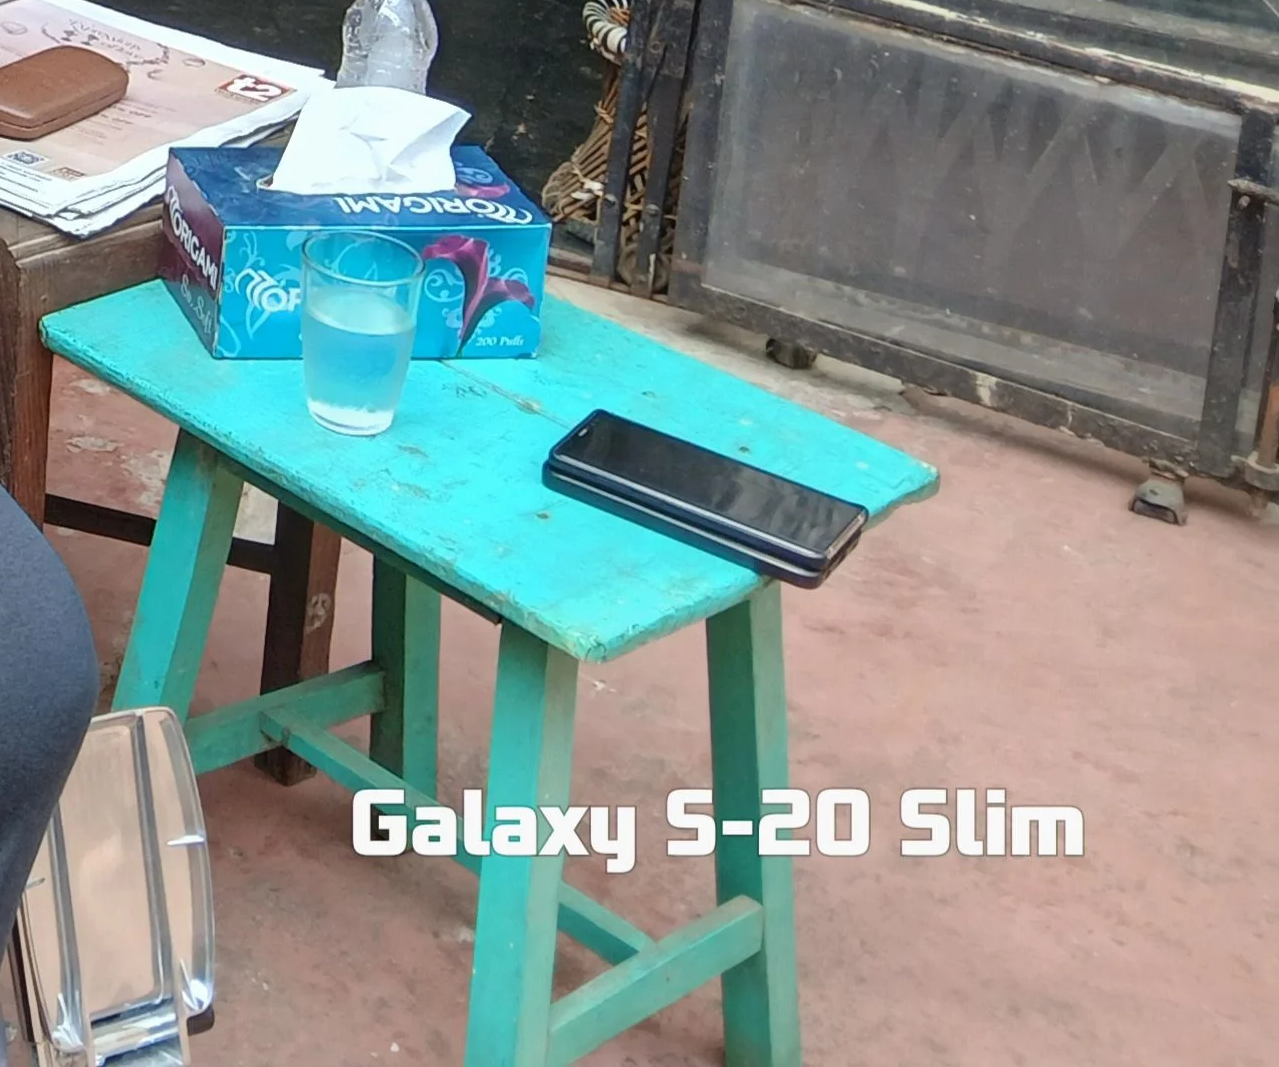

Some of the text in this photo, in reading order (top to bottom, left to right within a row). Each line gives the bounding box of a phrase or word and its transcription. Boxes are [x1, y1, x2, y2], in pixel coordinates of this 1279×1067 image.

[226, 76, 283, 102] t2
[334, 196, 507, 218] ORIGAMI
[168, 201, 219, 290] ORIGAMI
[475, 336, 498, 347] 200
